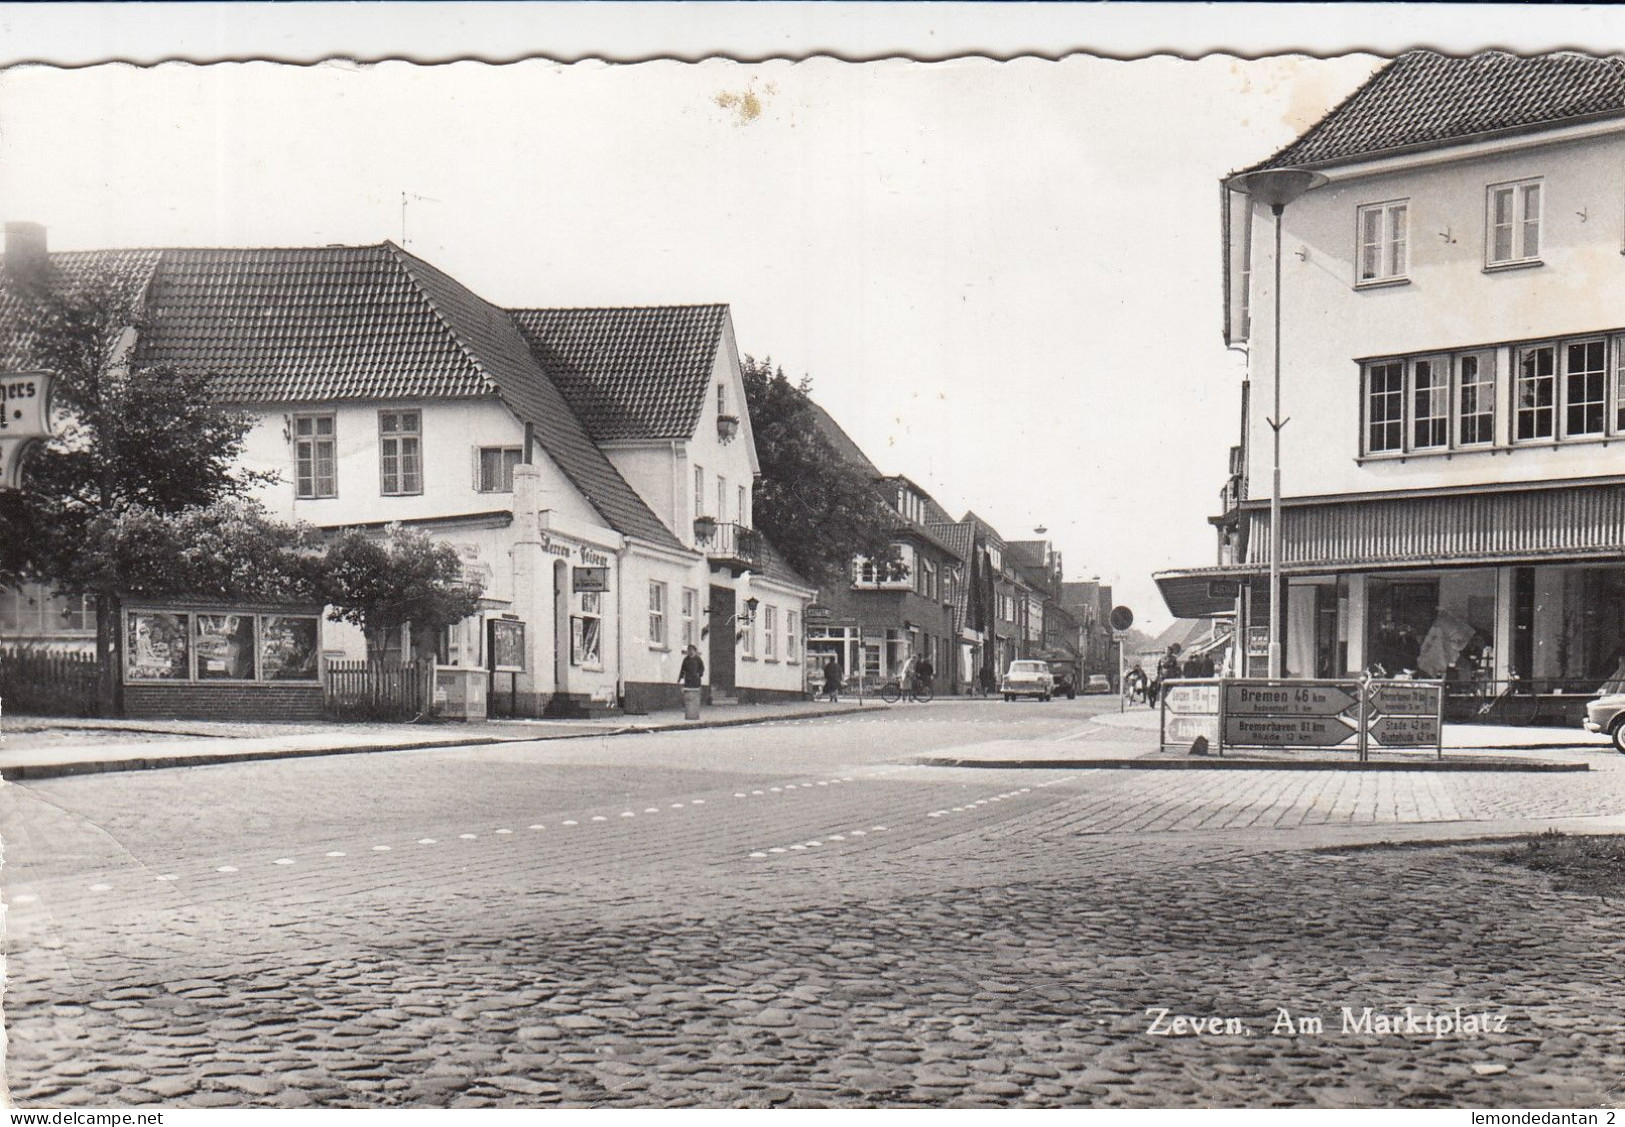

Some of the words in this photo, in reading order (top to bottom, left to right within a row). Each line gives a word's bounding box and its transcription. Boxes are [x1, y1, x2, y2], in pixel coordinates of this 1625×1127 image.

[1241, 688, 1289, 702] Bremen
[1295, 688, 1309, 702] 46
[1313, 692, 1327, 702] km
[1239, 721, 1297, 731] Bremerhaven
[1313, 721, 1326, 732] km
[1386, 720, 1407, 730] Stade
[1421, 721, 1432, 730] km
[1299, 732, 1312, 741] km
[1381, 731, 1414, 742] Buxtehude
